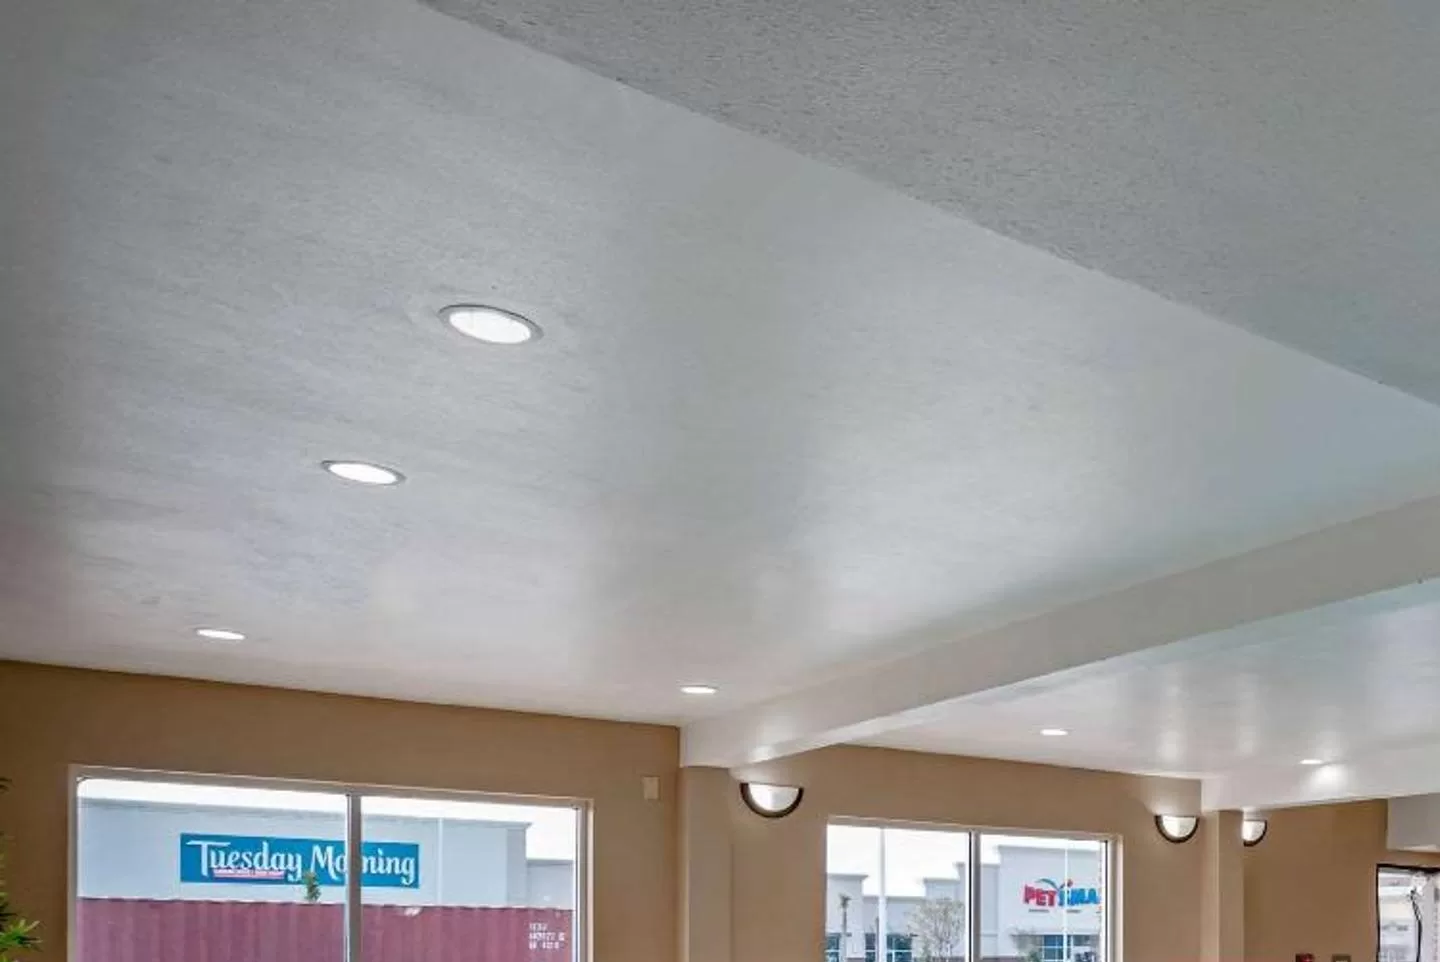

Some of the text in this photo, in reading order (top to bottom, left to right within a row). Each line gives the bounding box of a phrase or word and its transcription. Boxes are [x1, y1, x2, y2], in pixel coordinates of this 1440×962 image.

[186, 840, 415, 885] Tuesday Moning
[1023, 883, 1101, 907] PETSMA
